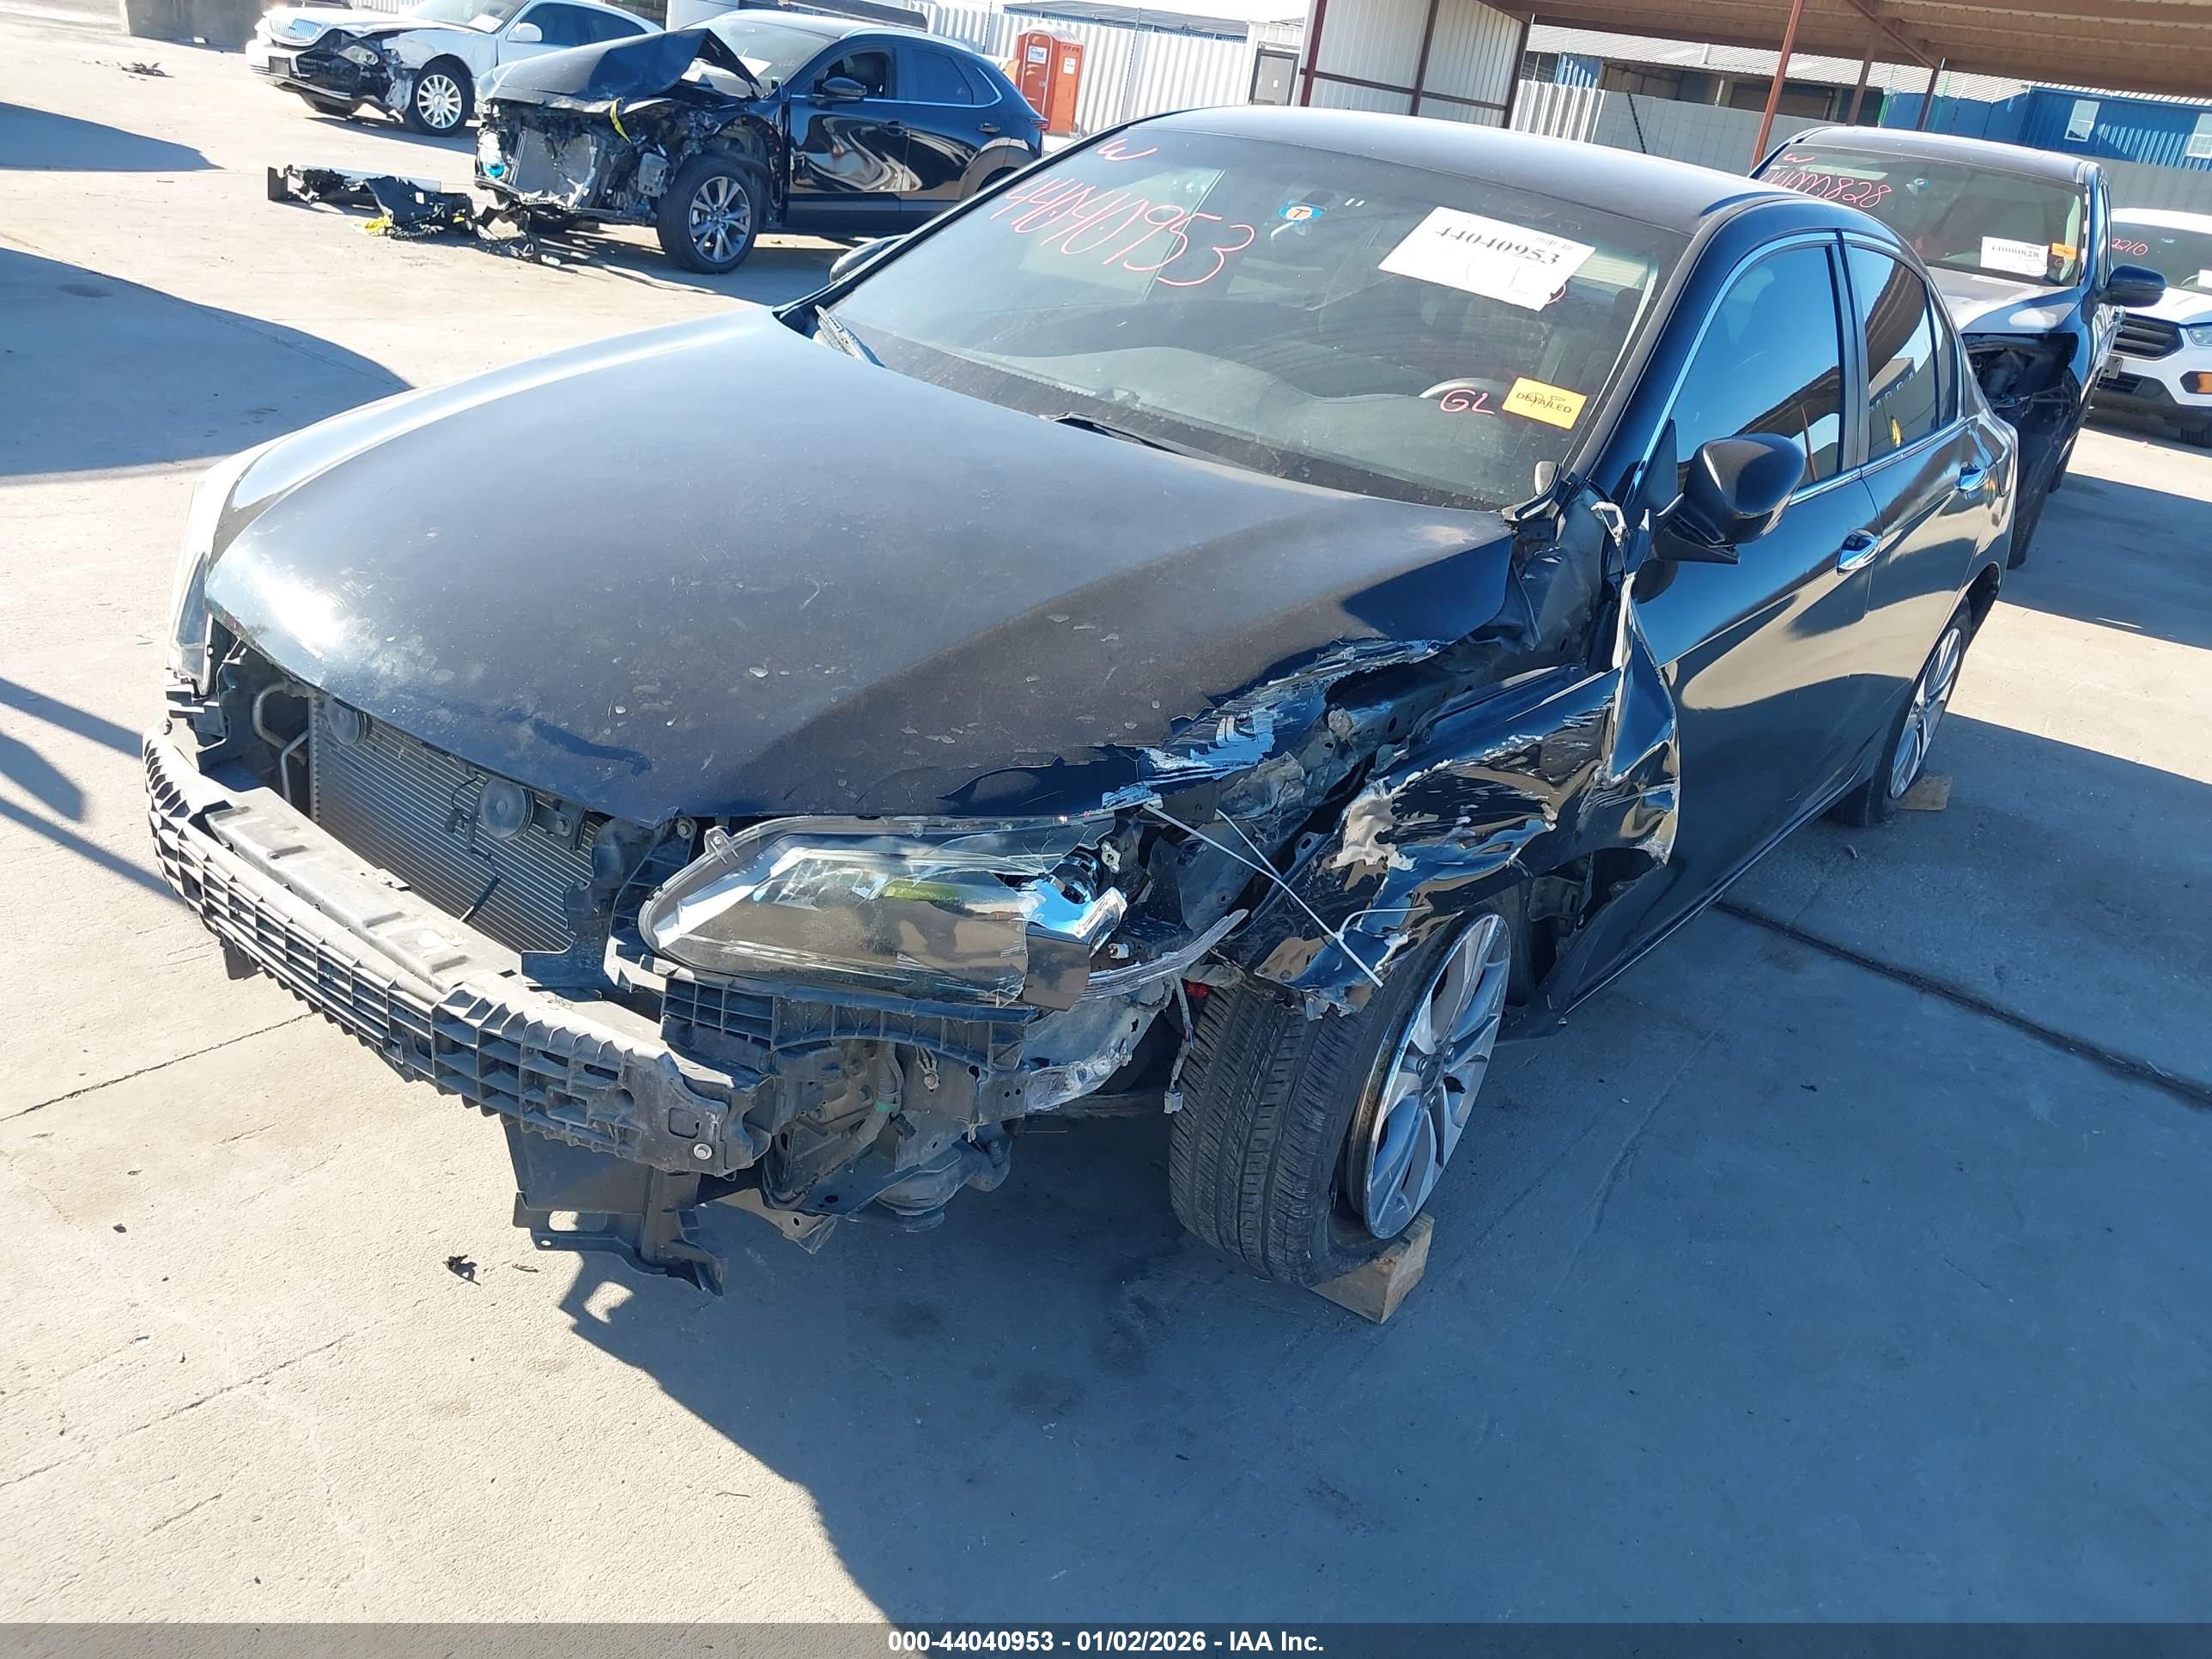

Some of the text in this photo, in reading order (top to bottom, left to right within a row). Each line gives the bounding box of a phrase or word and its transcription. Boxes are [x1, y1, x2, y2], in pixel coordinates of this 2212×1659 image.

[989, 174, 1255, 286] 44040953
[1435, 226, 1561, 265] 44040953
[1439, 388, 1496, 416] GL
